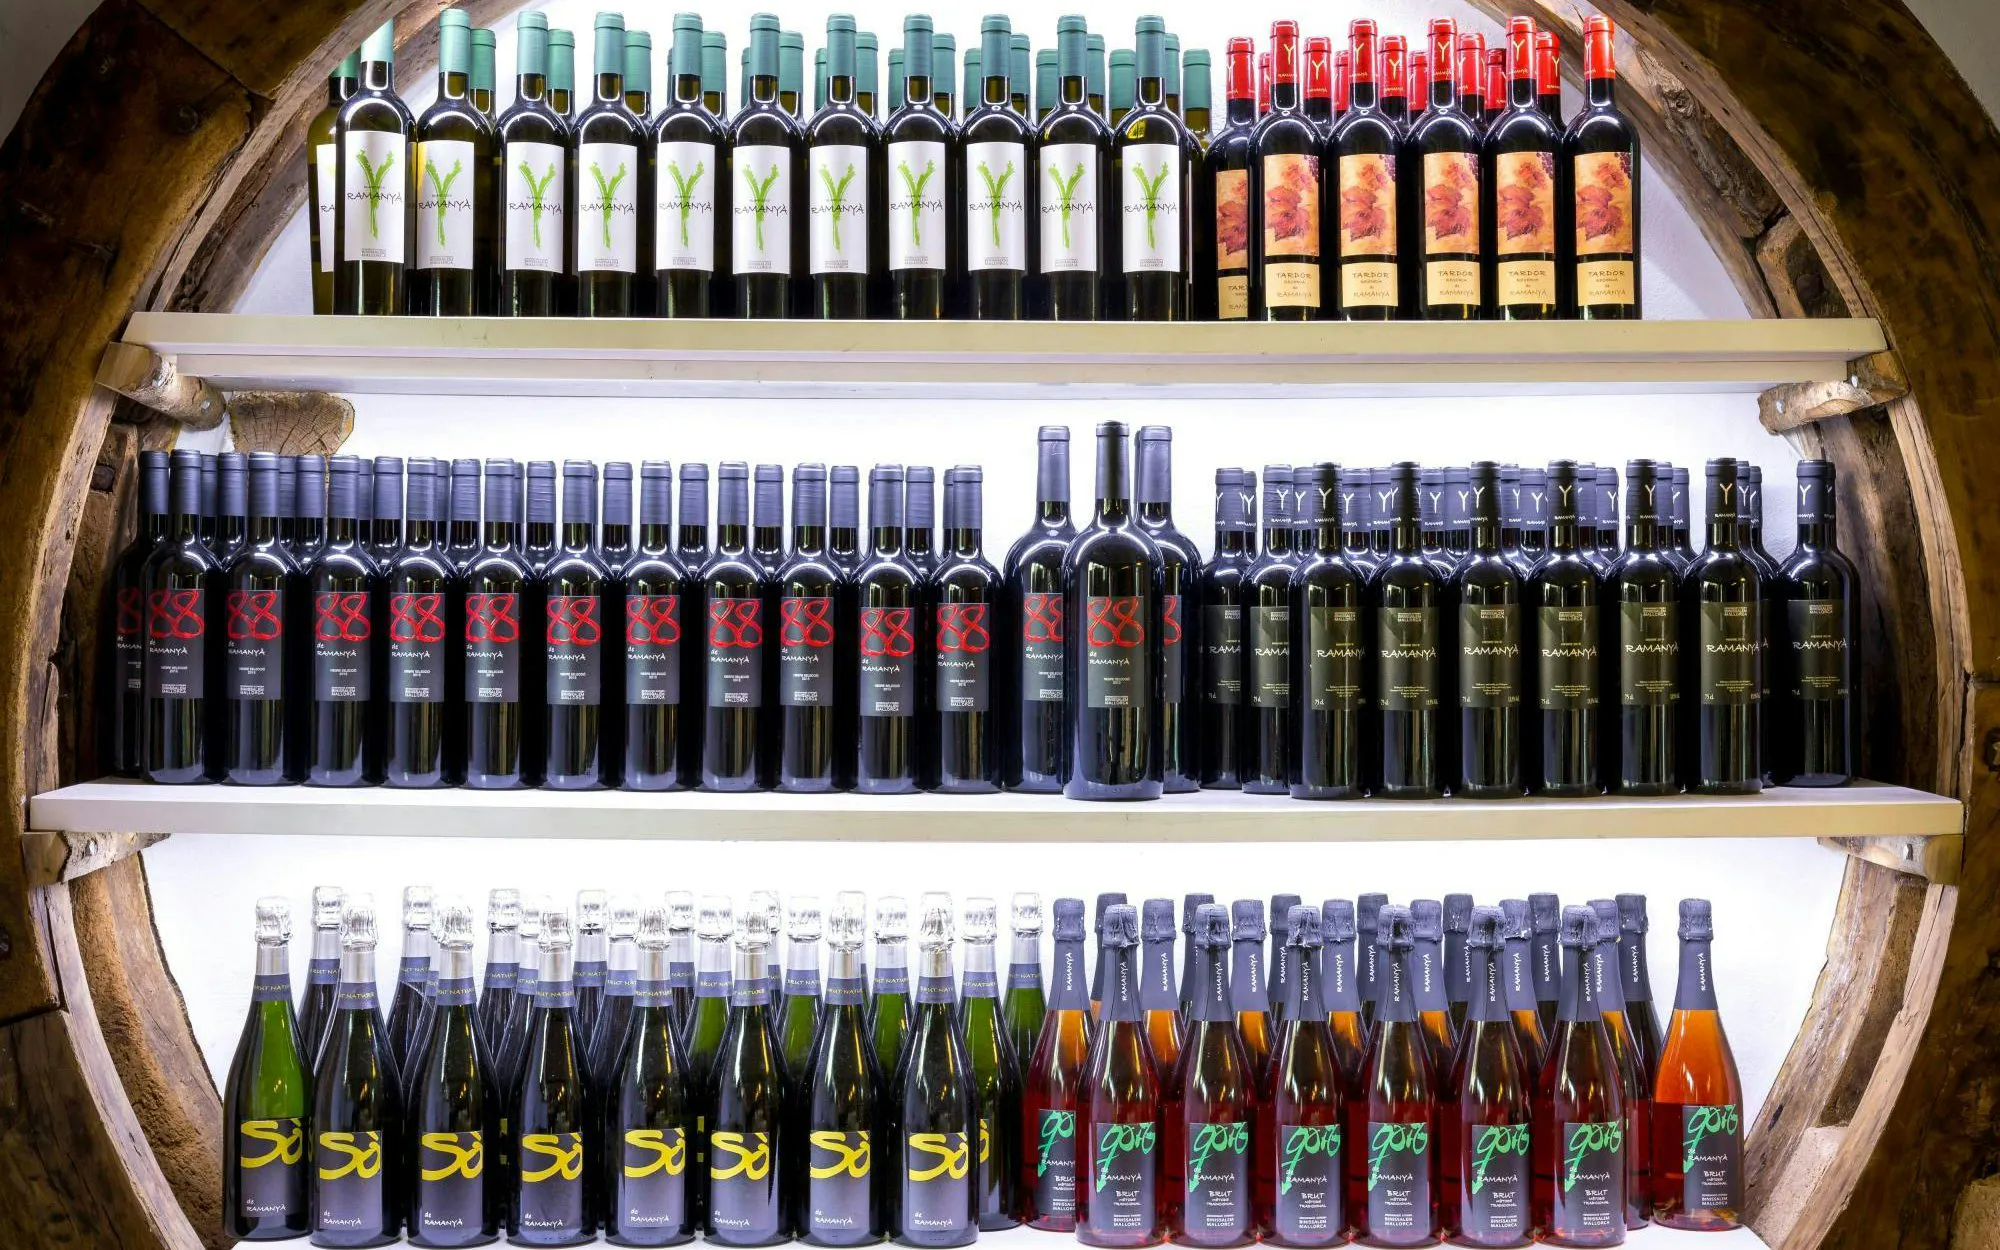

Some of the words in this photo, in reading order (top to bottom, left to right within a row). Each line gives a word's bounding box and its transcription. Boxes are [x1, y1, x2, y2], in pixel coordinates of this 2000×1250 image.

[228, 590, 281, 639] 88
[316, 592, 371, 641] 88
[390, 593, 445, 642] 88
[466, 593, 519, 642] 88
[547, 596, 601, 644] 88
[626, 595, 680, 644] 88
[710, 599, 762, 648] 88
[781, 598, 834, 647] 88
[861, 608, 914, 657] 88
[937, 603, 990, 652] 88
[1088, 596, 1145, 647] 88
[1382, 646, 1437, 663] RAMANYÀ
[1464, 646, 1519, 659] RAMANYÀ
[1542, 647, 1597, 660] RAMANYÀ
[1116, 1190, 1140, 1198] BRUT
[1209, 1190, 1233, 1198] BRUT
[1301, 1192, 1325, 1200] BRUT
[1387, 1190, 1411, 1198] BRUT
[1492, 1191, 1515, 1199] BRUT
[1703, 1170, 1726, 1178] BRUT
